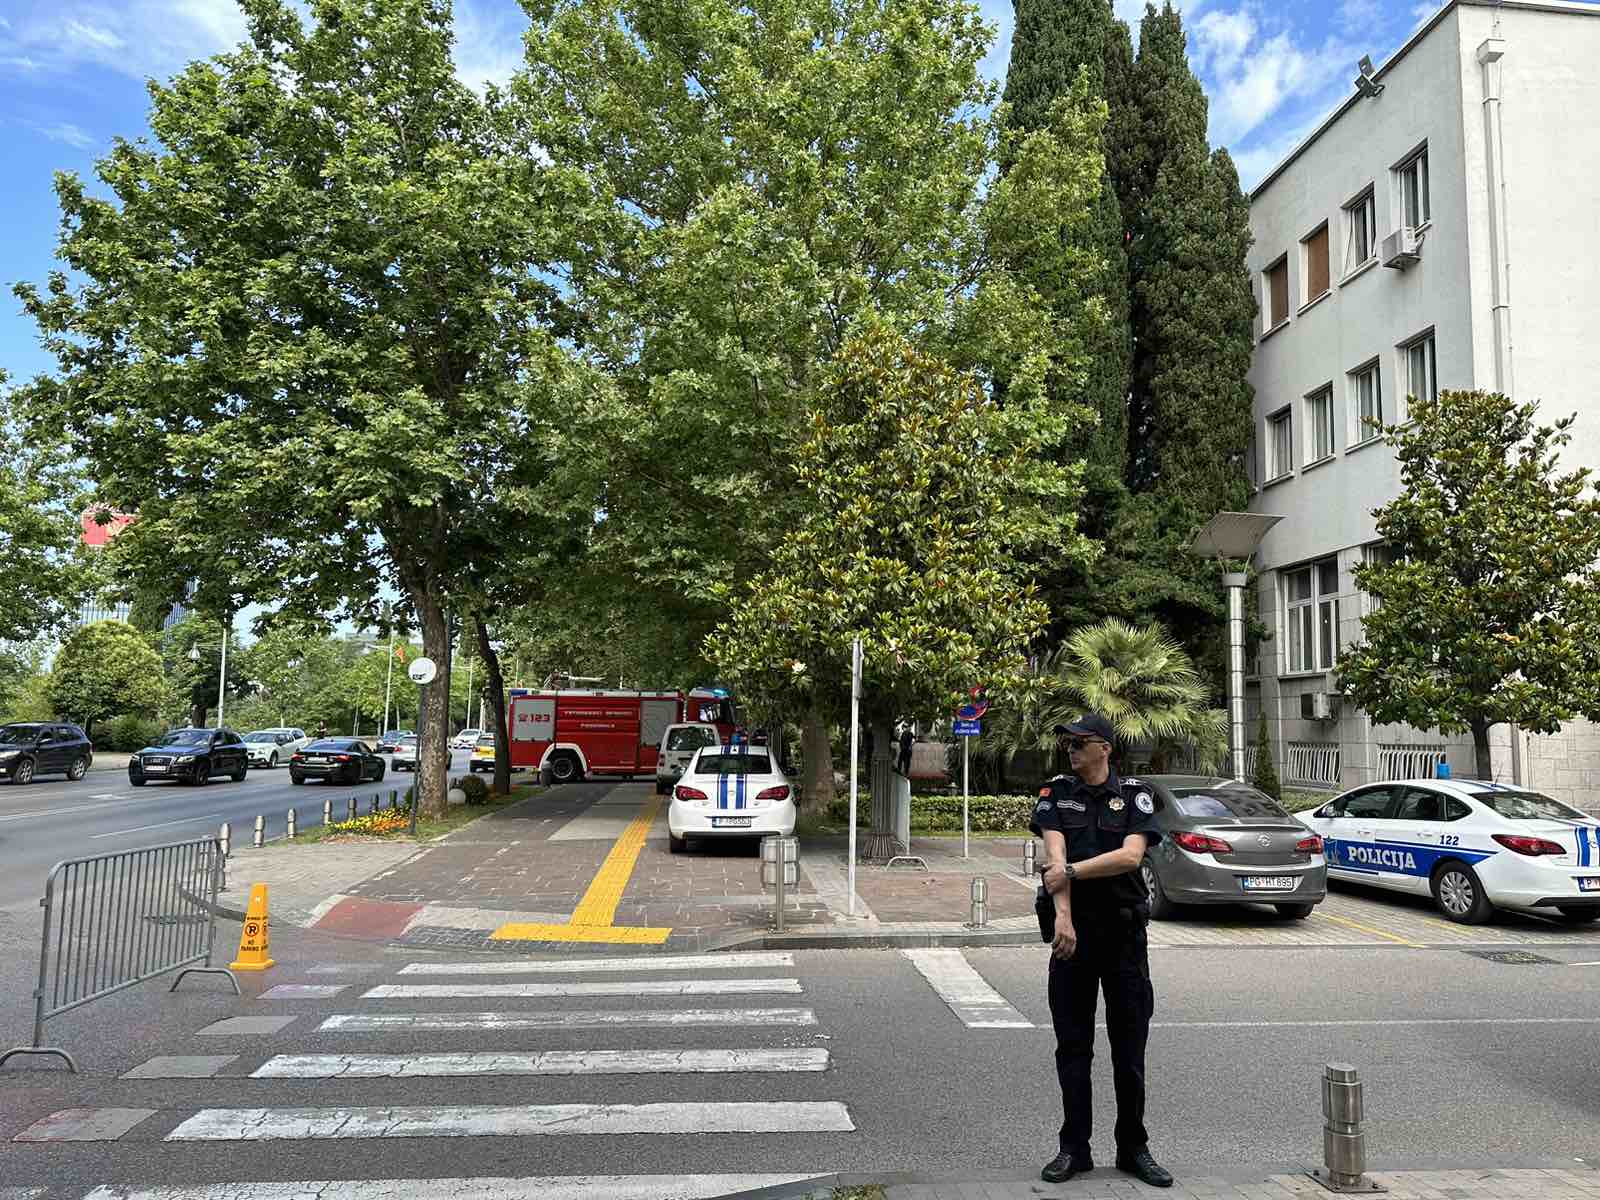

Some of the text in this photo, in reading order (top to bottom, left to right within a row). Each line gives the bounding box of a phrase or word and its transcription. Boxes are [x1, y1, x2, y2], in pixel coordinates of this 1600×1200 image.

[531, 713, 551, 722] 123
[1440, 834, 1460, 846] 122
[1347, 846, 1417, 870] POLICIJA
